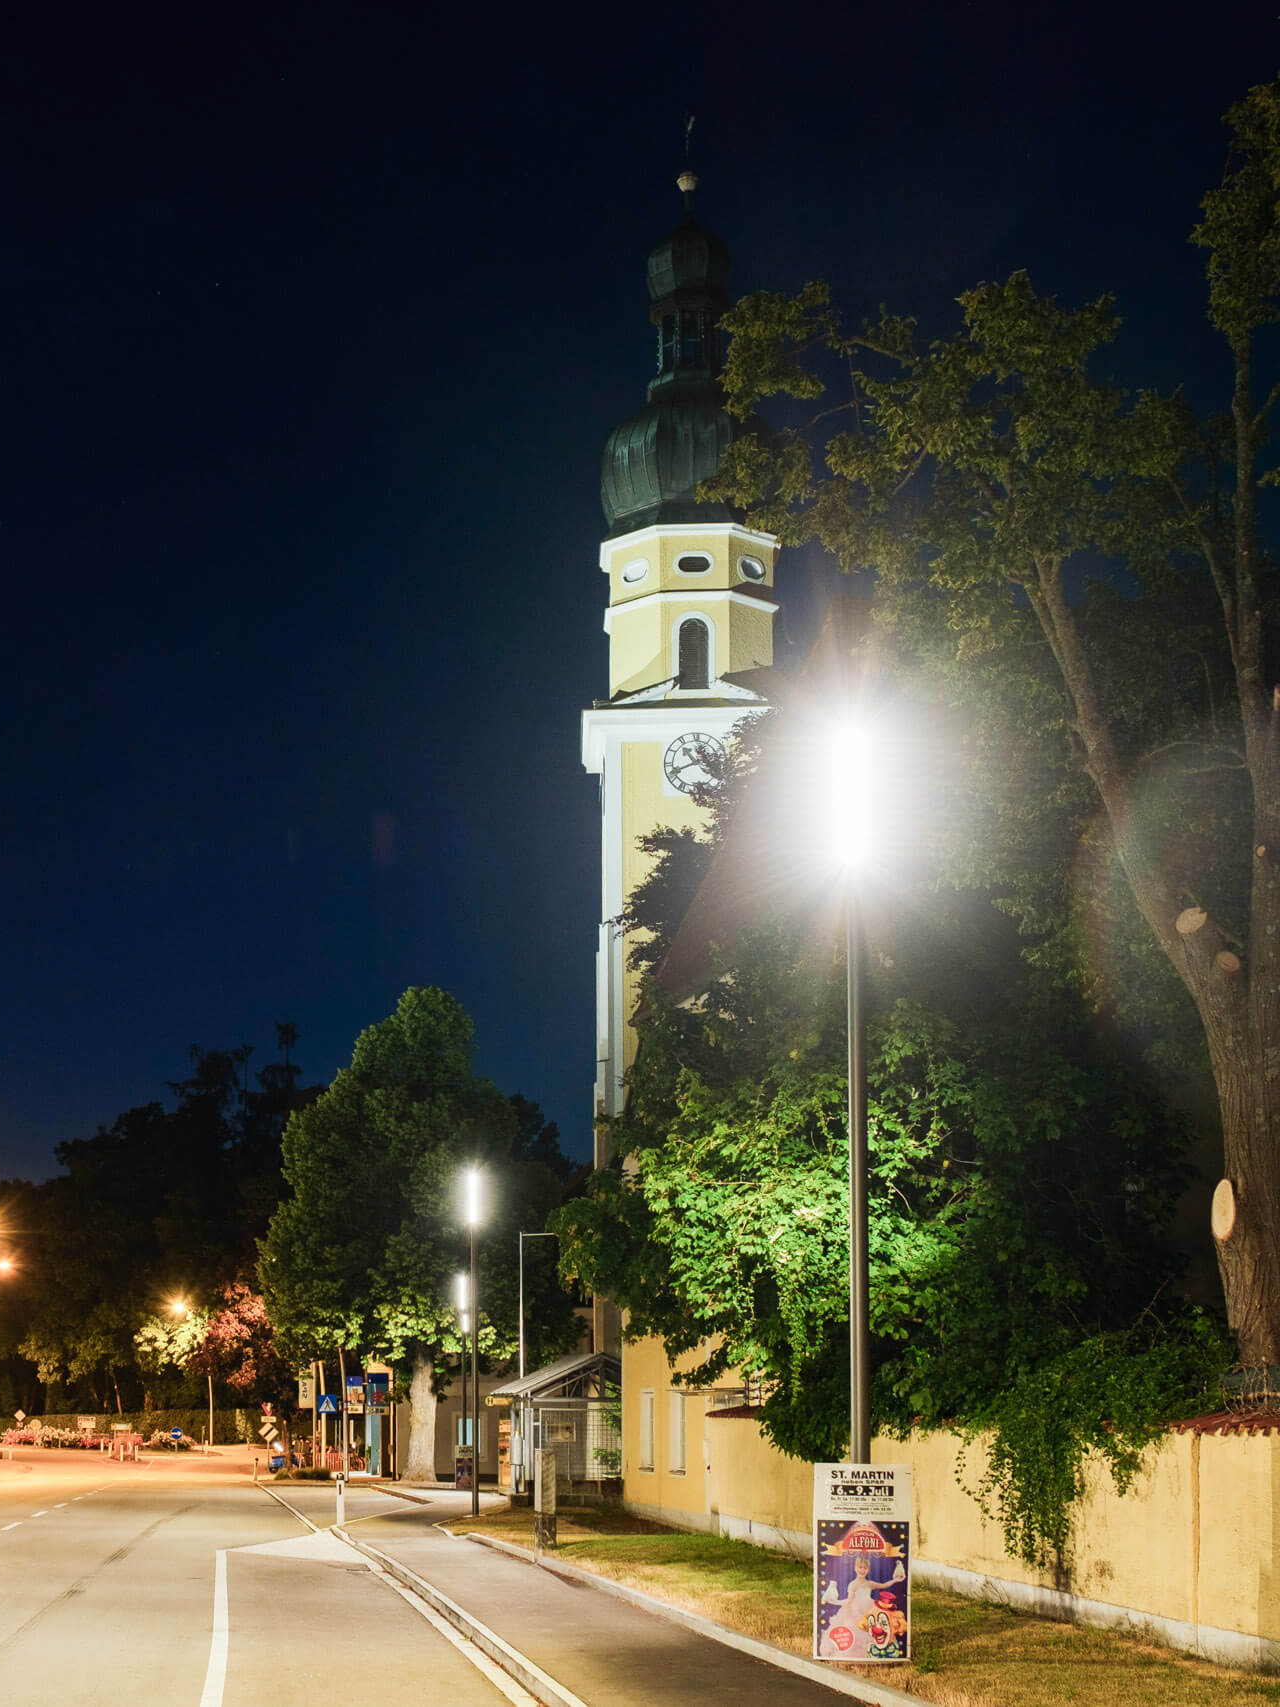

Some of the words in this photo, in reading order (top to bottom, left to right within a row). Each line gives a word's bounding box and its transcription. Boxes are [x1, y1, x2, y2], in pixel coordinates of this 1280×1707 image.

[831, 1470, 848, 1479] ST.
[851, 1470, 894, 1480] MARTIN
[868, 1486, 889, 1496] Juli
[848, 1536, 879, 1548] ALFONI
